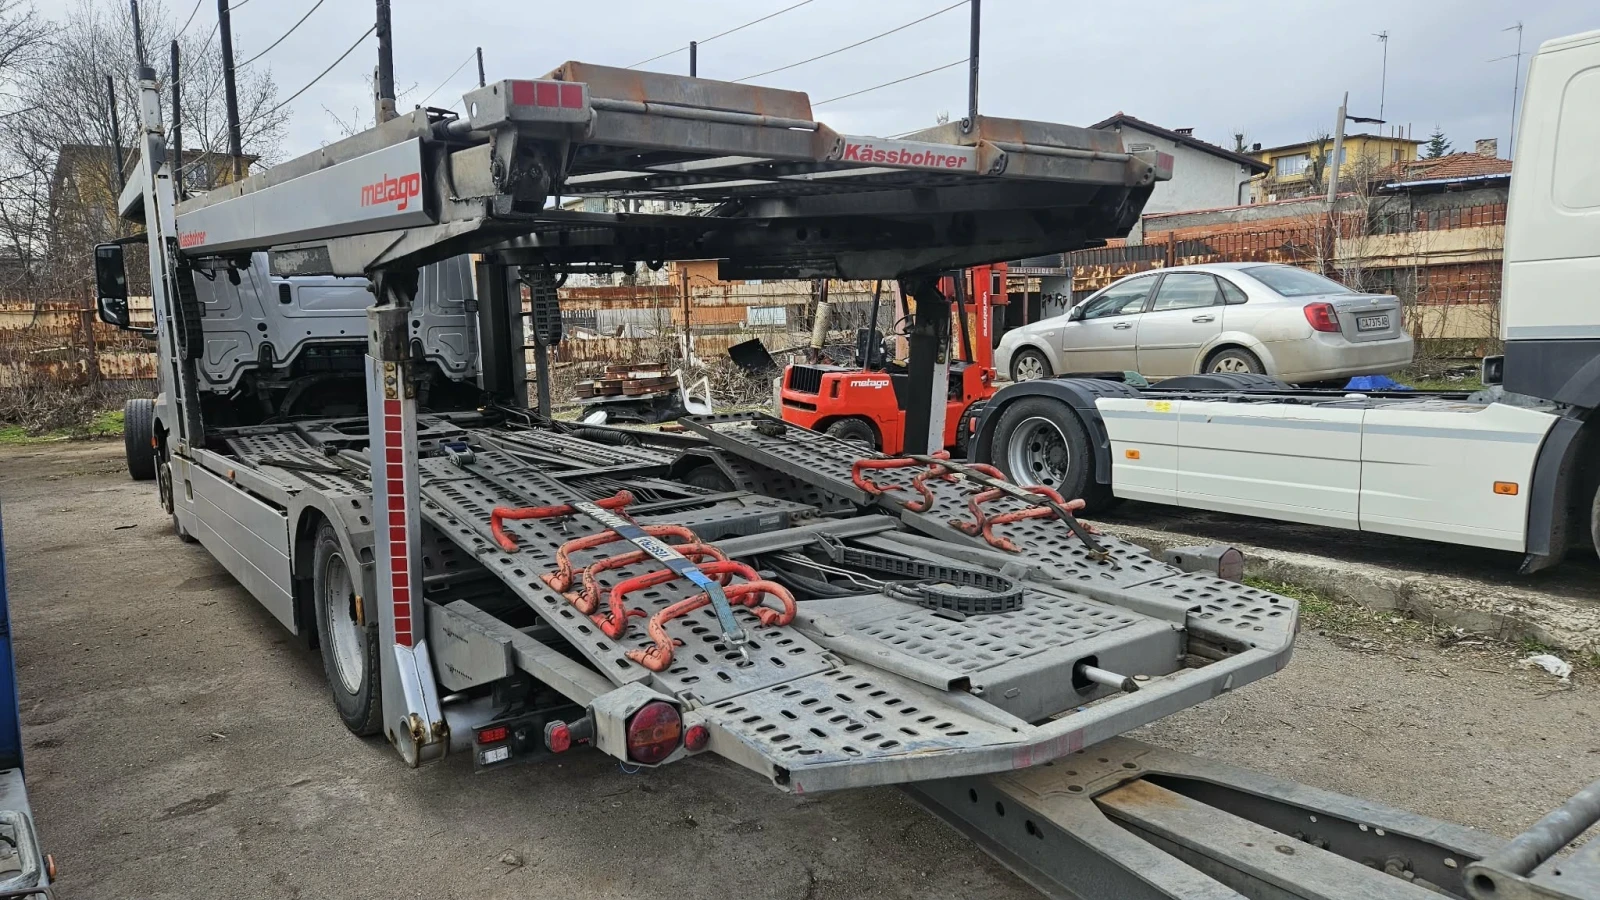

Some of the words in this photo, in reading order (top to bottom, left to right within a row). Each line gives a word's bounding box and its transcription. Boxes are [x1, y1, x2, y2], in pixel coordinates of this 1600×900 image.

[844, 144, 968, 168] Kässbohrer
[361, 173, 420, 211] metago
[850, 378, 890, 389] metago
